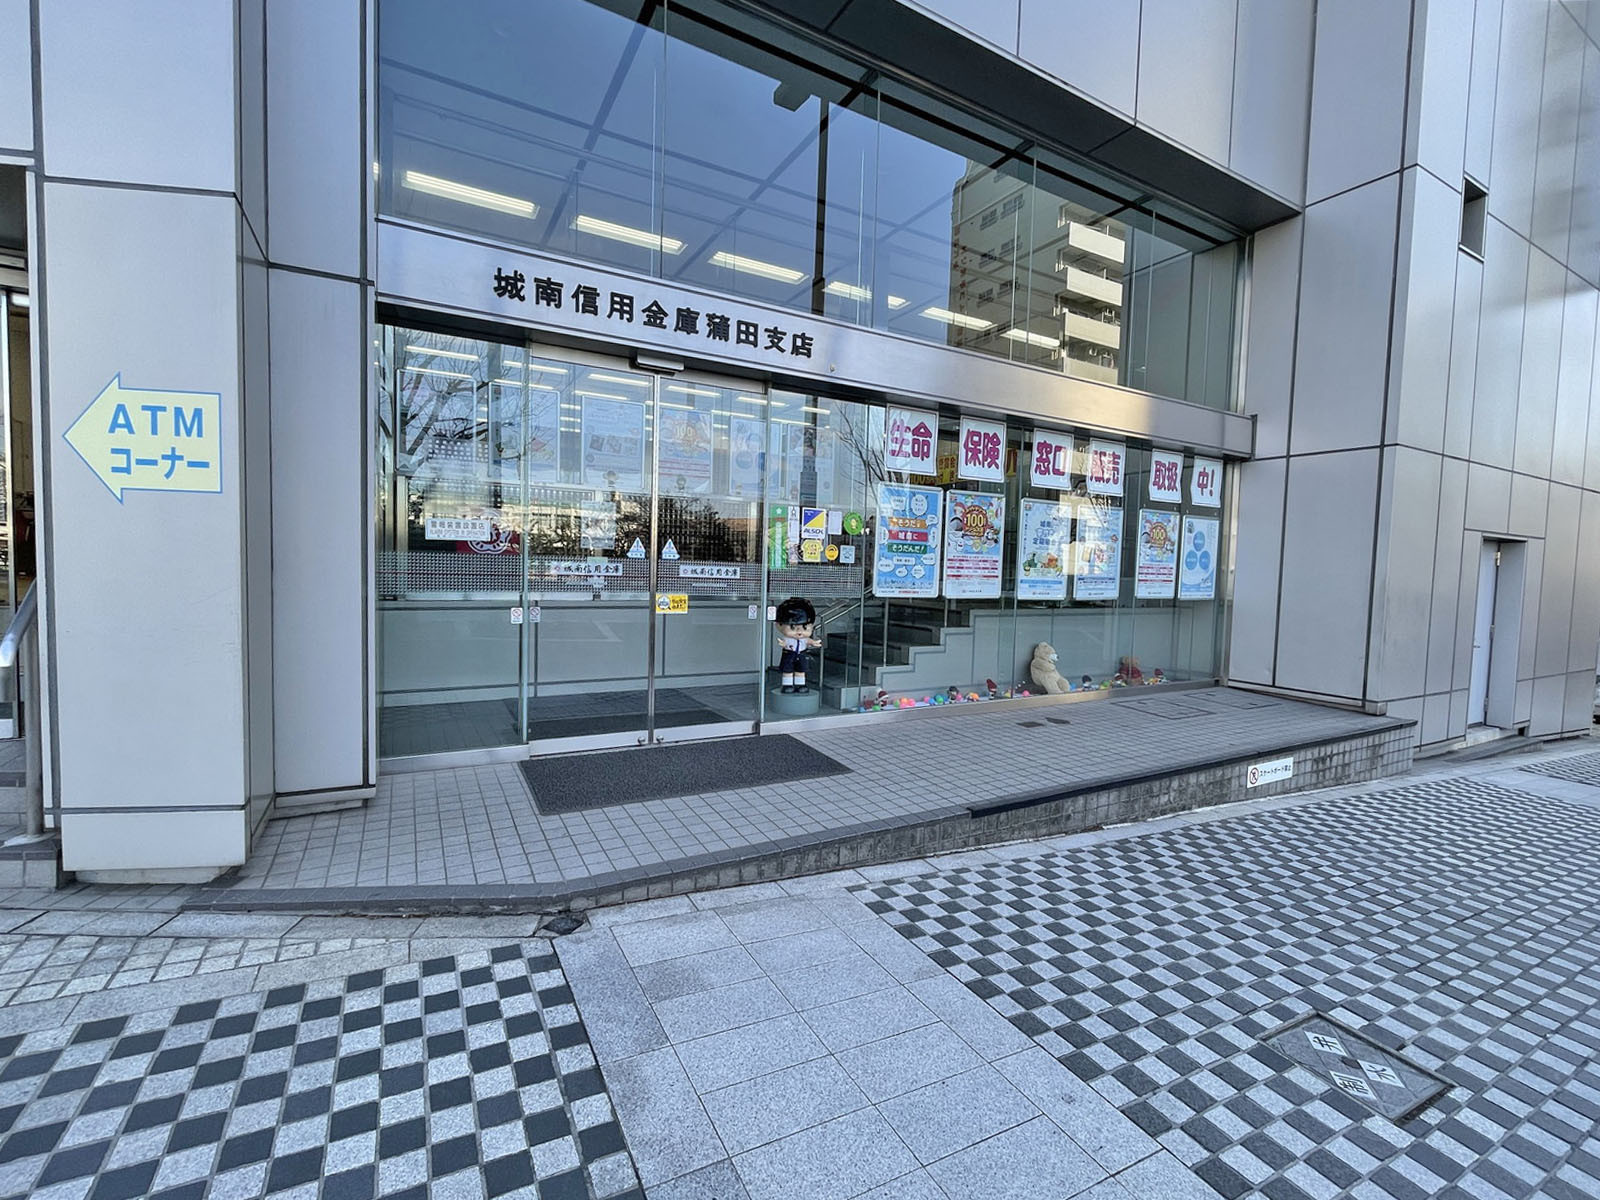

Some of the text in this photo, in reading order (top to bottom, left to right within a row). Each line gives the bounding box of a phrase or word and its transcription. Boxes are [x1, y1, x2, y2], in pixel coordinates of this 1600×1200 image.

[493, 267, 815, 358] 城南信用金庫蒲田支店
[107, 403, 204, 438] ATM
[110, 447, 210, 479] コーナー
[963, 429, 1001, 470] 保険
[1152, 460, 1178, 492] 取扱
[966, 513, 984, 527] 100
